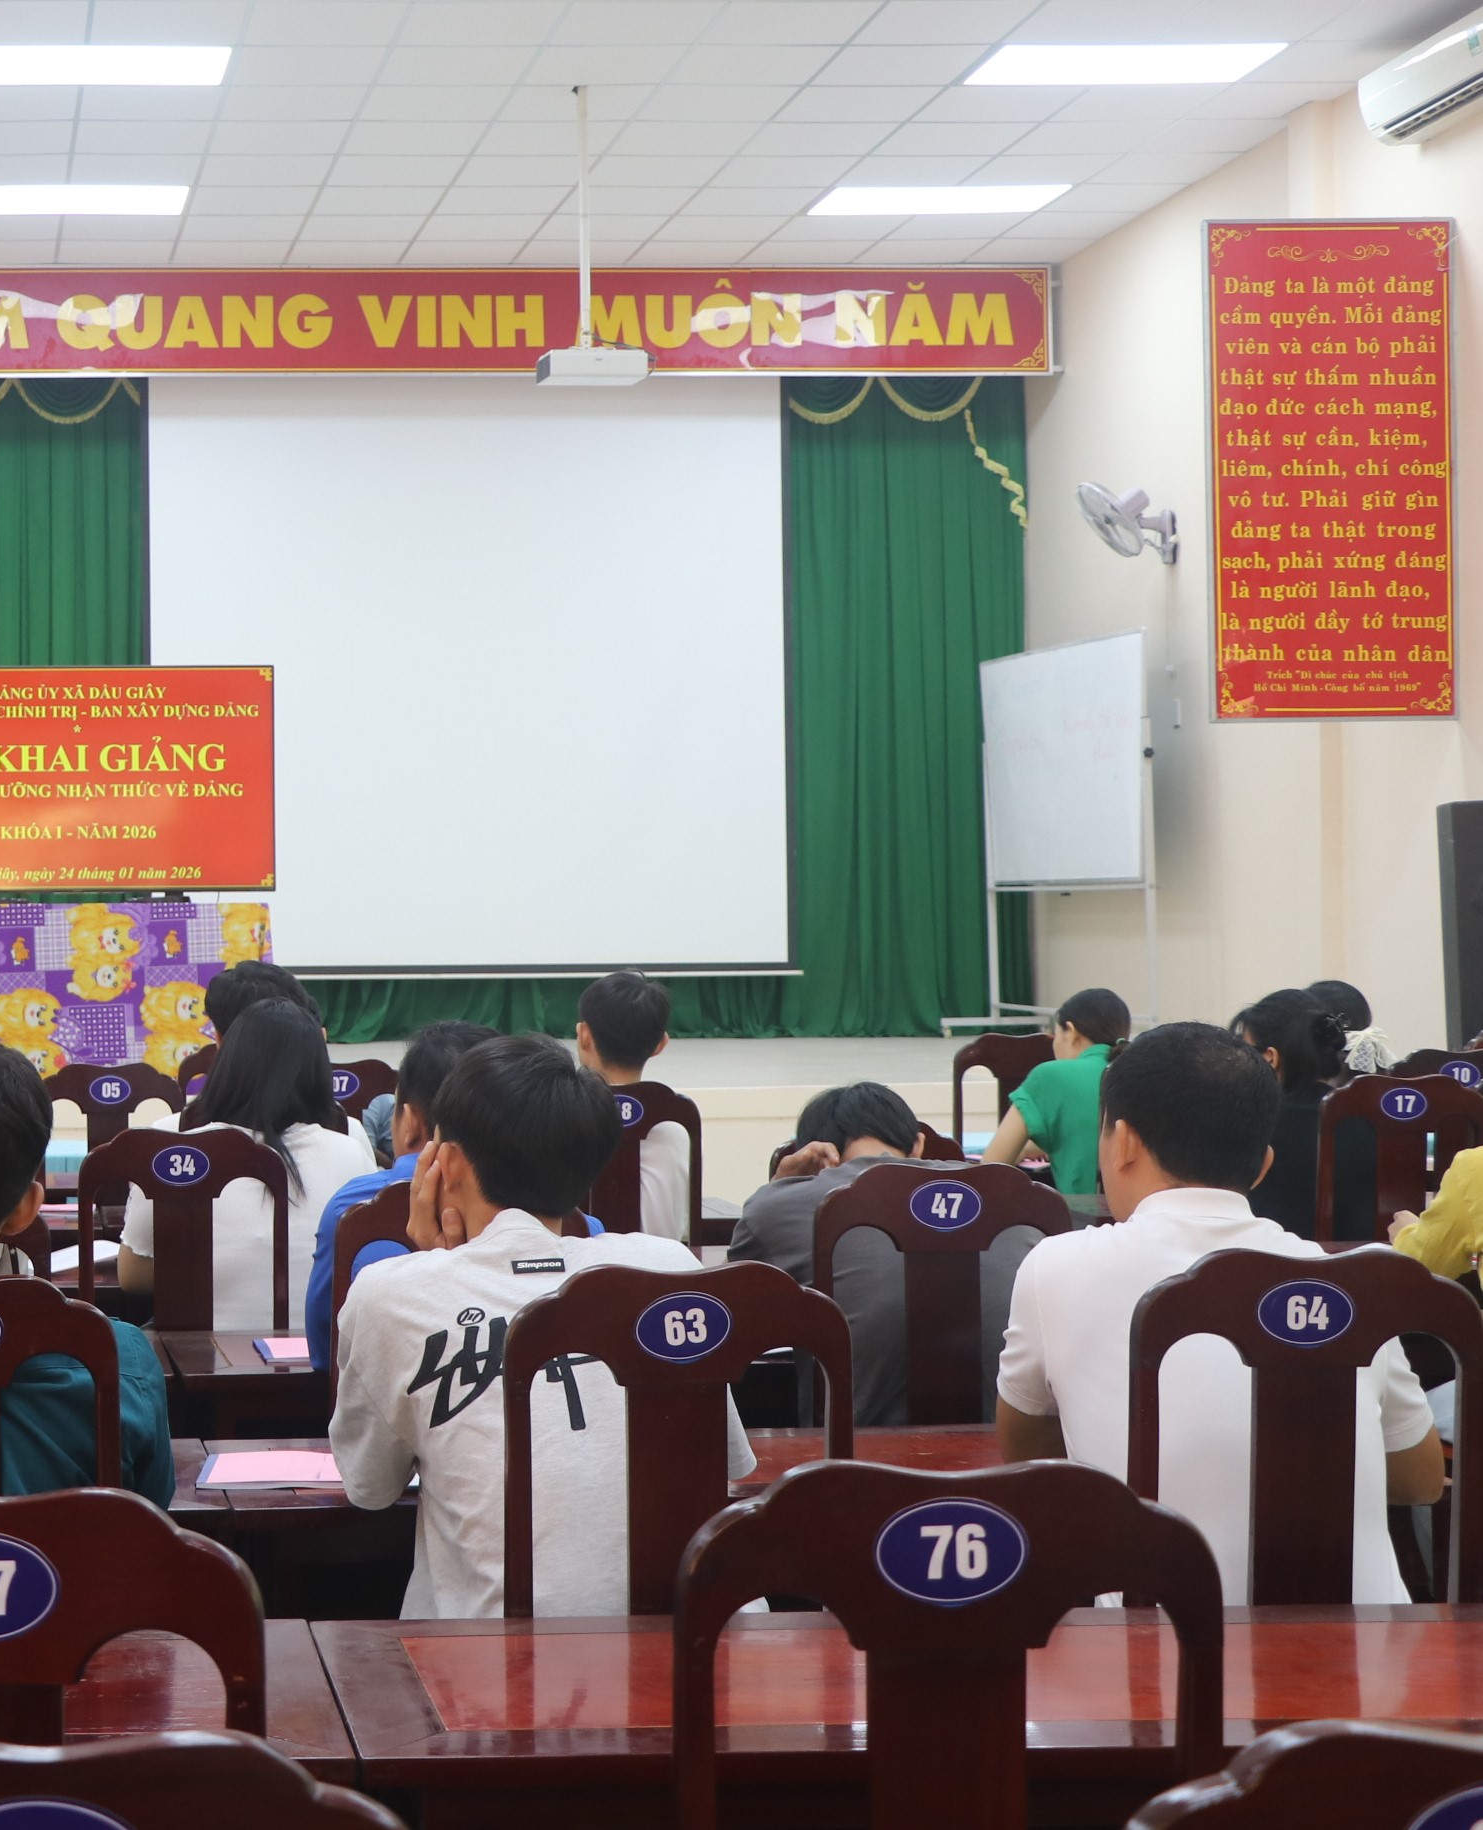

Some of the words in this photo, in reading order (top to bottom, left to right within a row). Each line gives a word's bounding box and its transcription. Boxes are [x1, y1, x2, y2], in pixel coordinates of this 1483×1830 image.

[1224, 275, 1275, 297] Đảng
[1286, 278, 1305, 293] ta
[1312, 277, 1330, 293] là
[1336, 278, 1375, 298] một
[1384, 275, 1434, 296] đảng
[56, 293, 334, 352] QUANG
[357, 294, 545, 349] VINH
[577, 277, 802, 348] MUÔN
[835, 280, 1014, 347] NĂM
[1220, 304, 1261, 324] cầm
[1270, 305, 1336, 328] quyền.
[1345, 303, 1383, 323] Mỗi
[1392, 305, 1442, 326] đảng
[1225, 338, 1269, 354] viên
[1279, 337, 1302, 354] và
[1311, 337, 1347, 354] cán
[1356, 337, 1380, 358] bộ
[1389, 335, 1436, 357] phải
[1220, 368, 1264, 389] thật
[1273, 371, 1297, 390] sự
[1305, 365, 1358, 385] thấm
[1369, 365, 1436, 385] nhuần
[1217, 395, 1257, 422] đạo
[1266, 398, 1304, 415] đức
[1315, 398, 1365, 415] cách
[1375, 401, 1436, 418] mạng,
[1226, 429, 1271, 450] thật
[1283, 432, 1307, 450] sự
[1369, 428, 1427, 450] kiệm,
[1222, 460, 1272, 478] liêm,
[1281, 459, 1346, 479] chính,
[1356, 459, 1388, 475] chí
[1399, 457, 1447, 481] công
[1228, 490, 1251, 507] vô
[1300, 489, 1348, 507] Phải
[1406, 490, 1439, 510] gìn
[1231, 520, 1281, 541] đảng
[1290, 522, 1311, 538] ta
[1323, 520, 1366, 542] thật
[1377, 522, 1436, 540] trong
[1222, 552, 1271, 574] sạch,
[1278, 550, 1323, 573] phải
[1334, 551, 1385, 571] xứng
[1395, 548, 1448, 574] đáng
[1231, 580, 1250, 598] là
[1260, 581, 1317, 601] người
[1330, 581, 1376, 598] lãnh
[1386, 580, 1429, 602] đạo,
[1219, 610, 1240, 632] là
[1249, 612, 1305, 633] người
[1362, 612, 1383, 629] tớ
[1392, 610, 1449, 634] trung
[1222, 643, 1284, 664] thành
[1296, 644, 1332, 661] của
[1344, 644, 1396, 661] nhân
[38, 684, 59, 699] ỦY
[63, 684, 84, 699] XÃ
[126, 683, 165, 699] GIÂY
[50, 706, 77, 720] TRỊ
[91, 706, 122, 717] BAN
[127, 702, 160, 717] XÂY
[164, 703, 209, 720] DỰNG
[214, 702, 258, 717] ĐẢNG
[100, 736, 226, 772] GIẢNG
[57, 783, 105, 801] NHẬN
[110, 780, 161, 798] THỨC
[193, 780, 243, 797] ĐẢNG
[1, 822, 52, 839] KHÓA
[57, 826, 61, 839] I
[77, 823, 116, 838] NĂM
[123, 825, 156, 838] 2026
[23, 867, 55, 882] ngày
[59, 867, 74, 879] 24
[77, 867, 115, 882] tháng
[119, 867, 133, 879] 01
[138, 868, 166, 879] năm
[170, 867, 201, 879] 2026
[1452, 1067, 1470, 1083] 10
[102, 1082, 120, 1098] 05
[1395, 1095, 1415, 1112] 17
[170, 1155, 195, 1176] 34
[931, 1193, 963, 1218] 47
[517, 1261, 562, 1270] Simpson
[1287, 1295, 1329, 1330] 64
[664, 1308, 707, 1346] 63
[921, 1523, 987, 1579] 76
